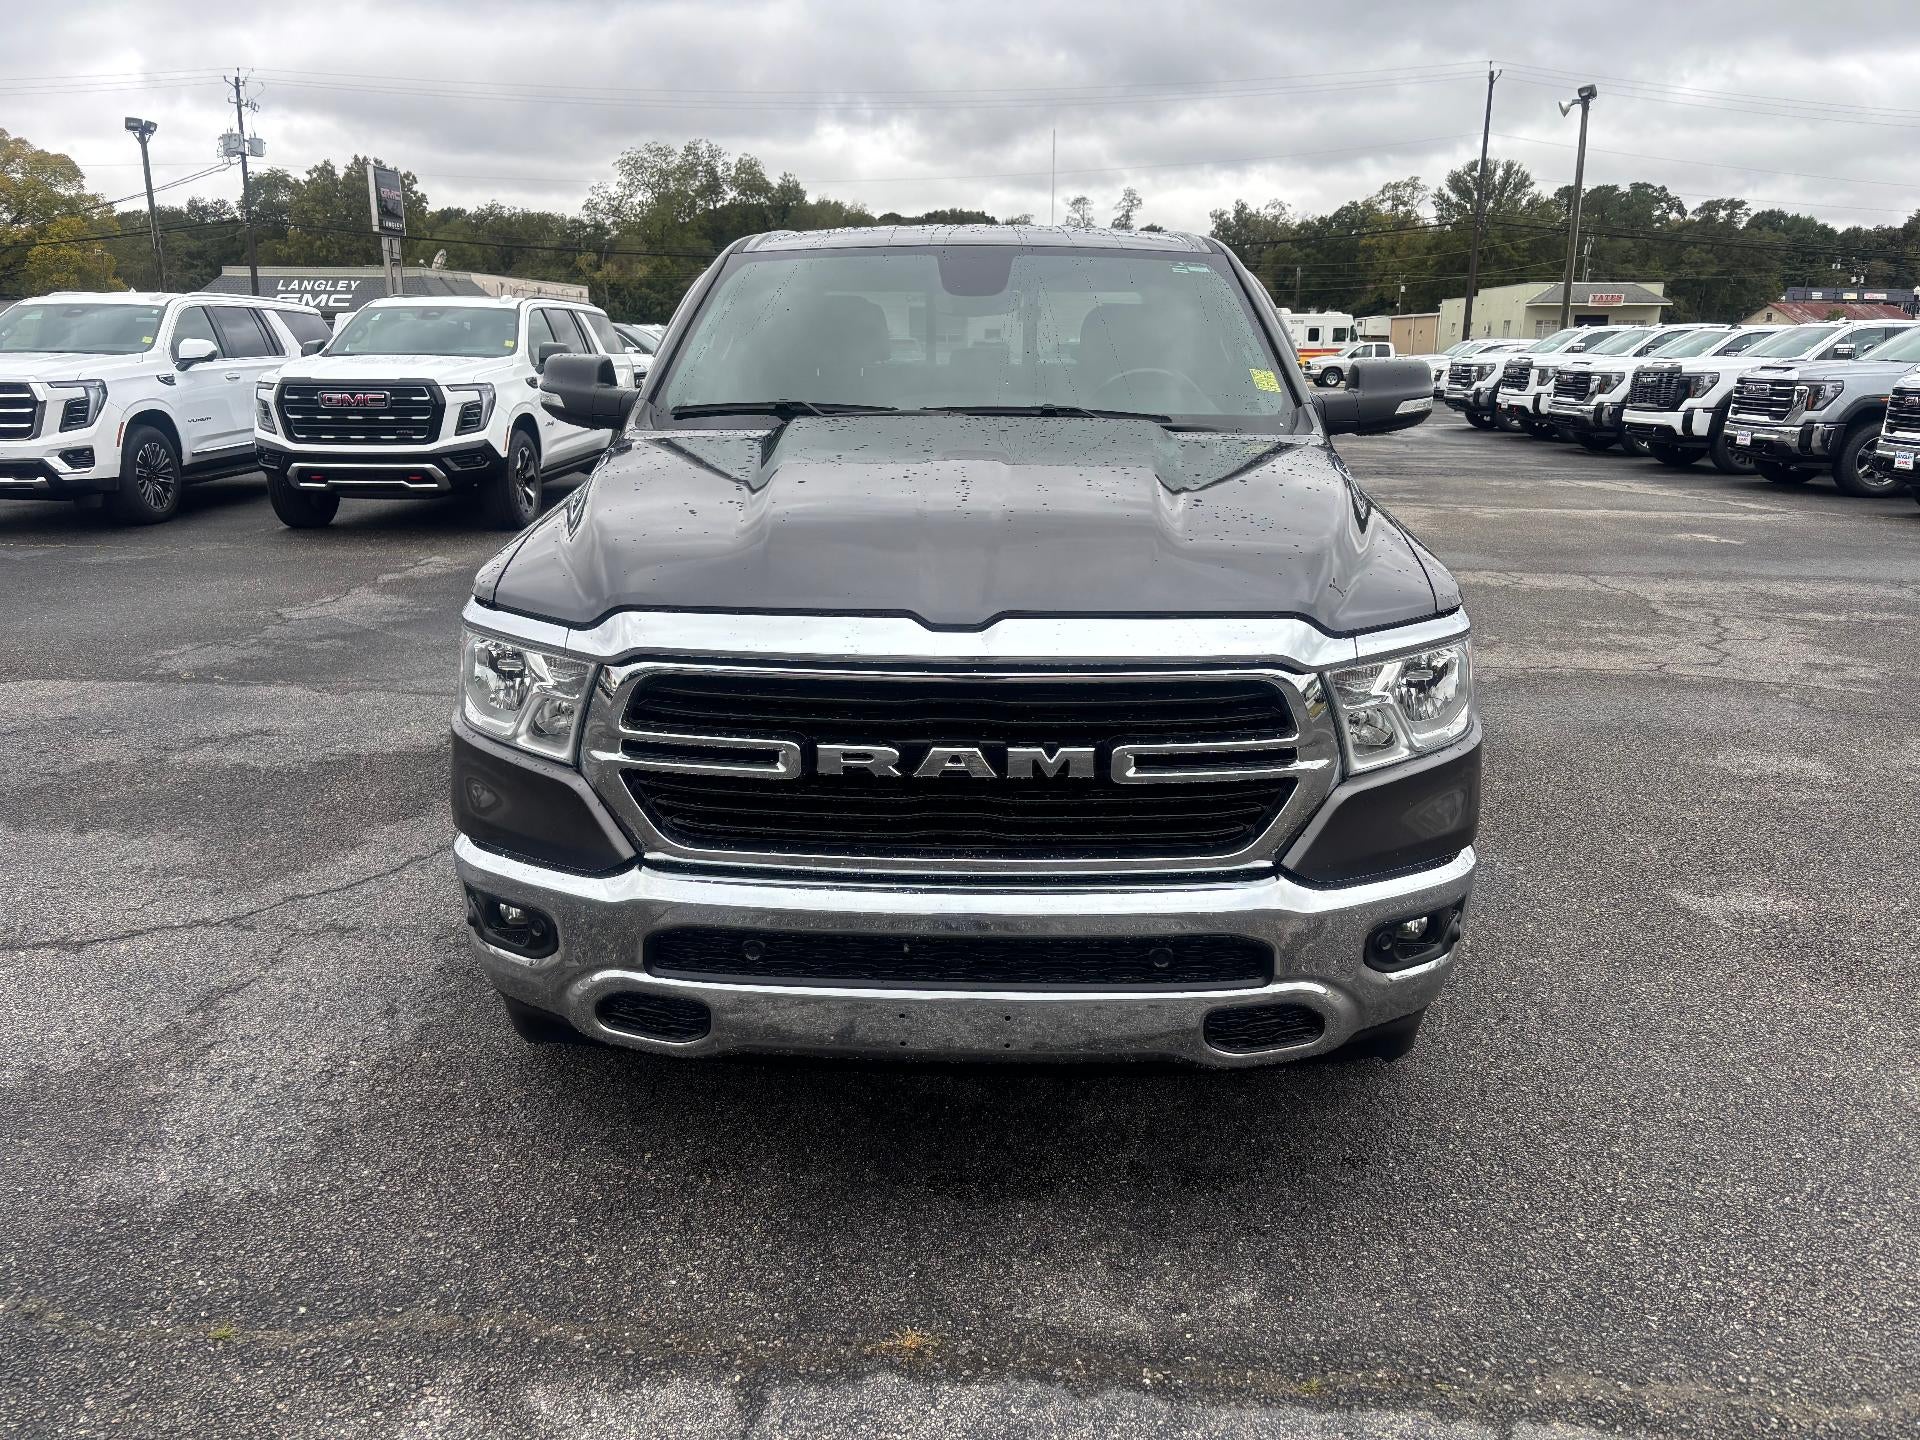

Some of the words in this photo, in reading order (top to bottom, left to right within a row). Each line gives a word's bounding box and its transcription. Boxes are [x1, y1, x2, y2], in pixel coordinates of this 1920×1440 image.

[277, 279, 361, 291] LANGLEY
[277, 293, 353, 307] GMC
[322, 393, 385, 407] GMC
[816, 744, 1096, 778] RAM
